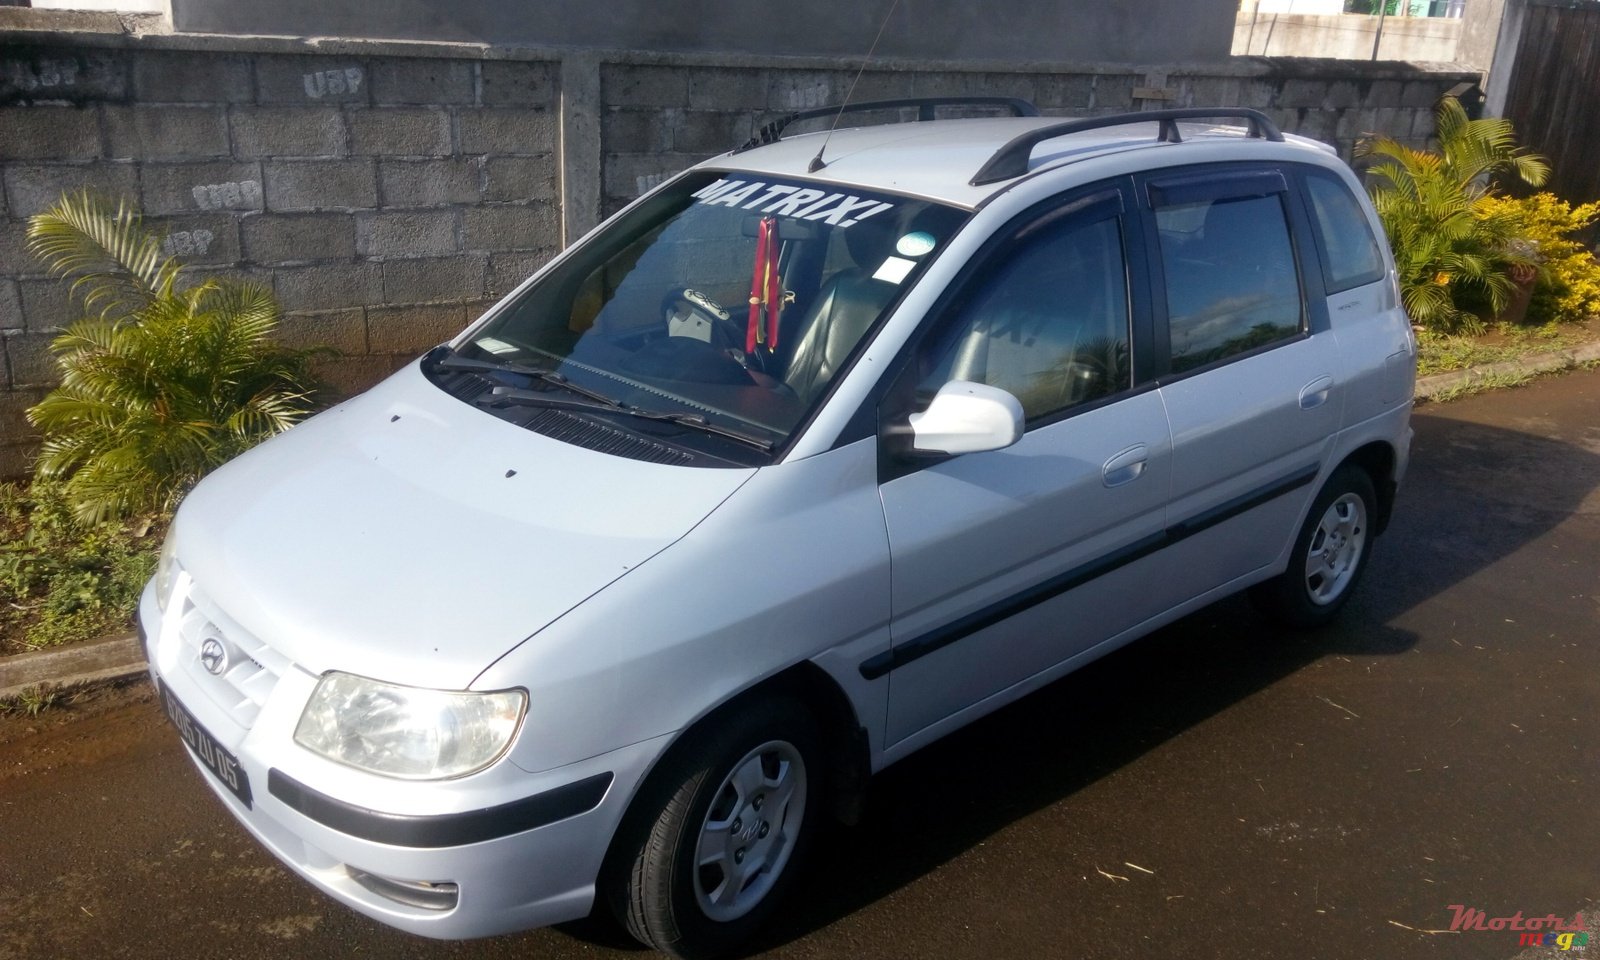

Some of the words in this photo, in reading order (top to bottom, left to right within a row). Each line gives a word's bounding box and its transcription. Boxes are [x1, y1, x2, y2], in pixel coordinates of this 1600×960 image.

[690, 178, 894, 228] MATRIX!
[194, 726, 215, 768] ZU
[216, 747, 238, 791] 05
